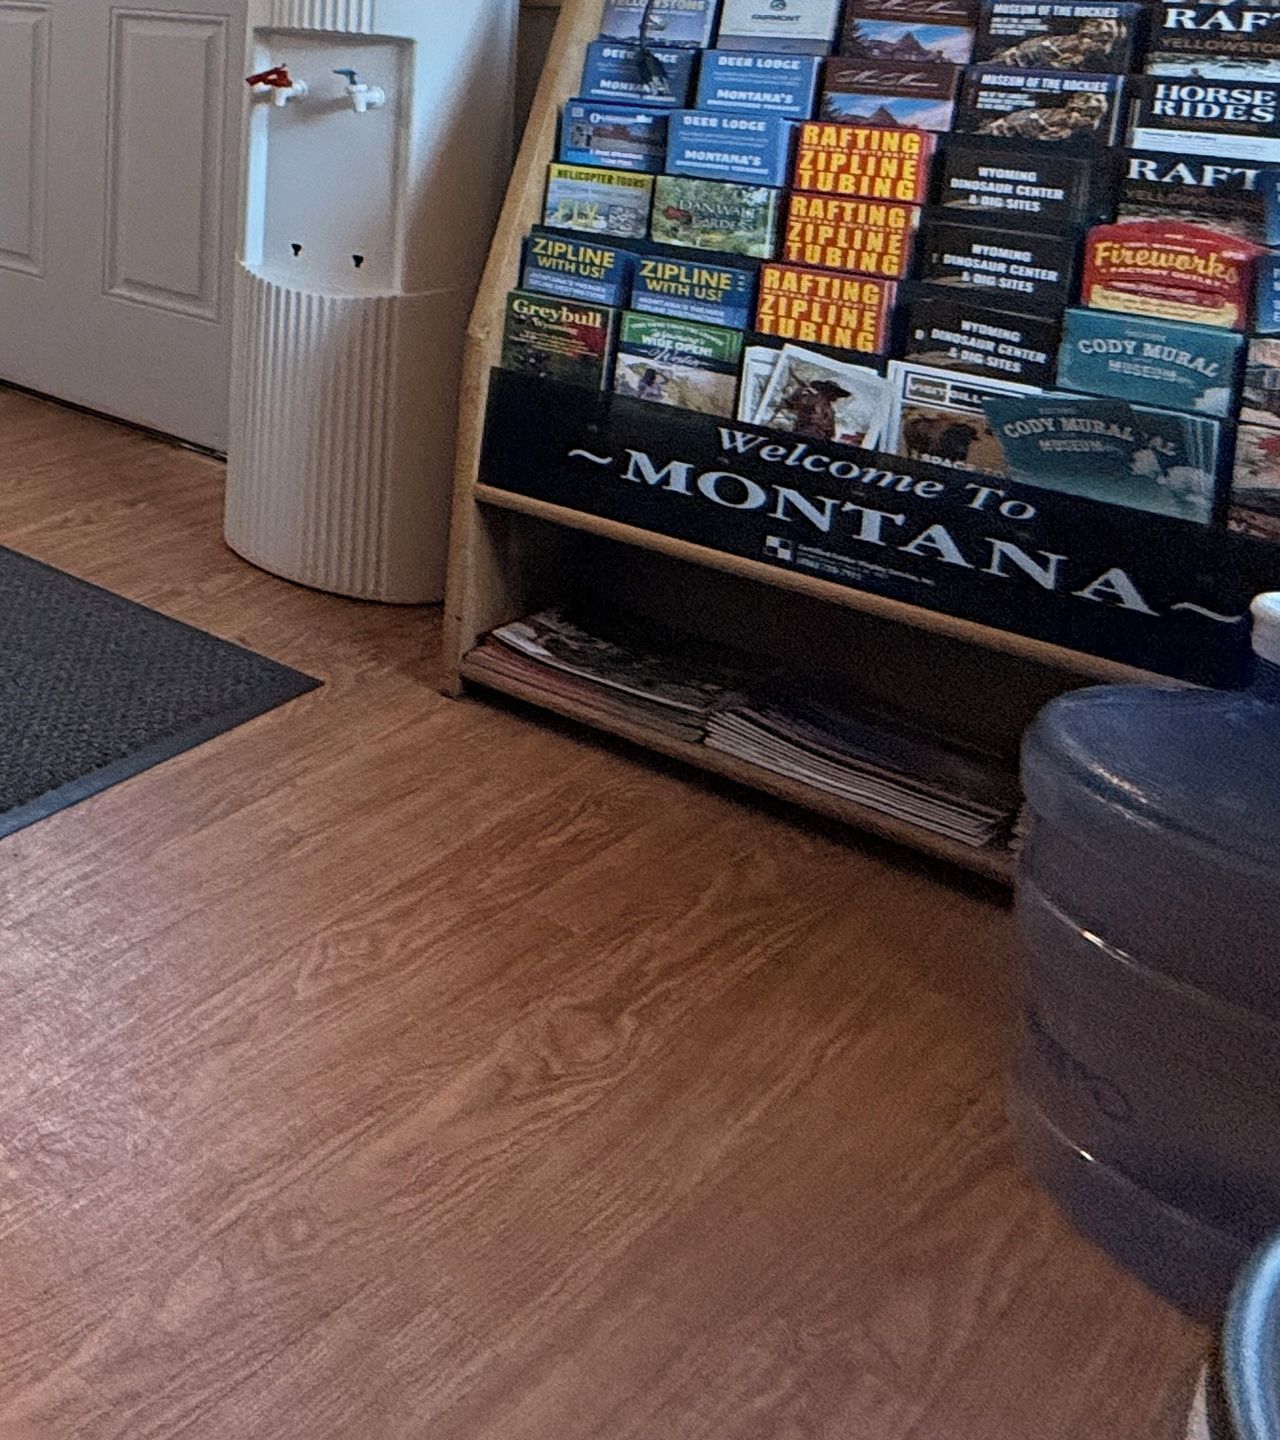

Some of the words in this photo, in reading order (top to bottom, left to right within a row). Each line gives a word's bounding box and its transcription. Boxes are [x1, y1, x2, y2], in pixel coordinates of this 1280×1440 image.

[717, 55, 754, 67] DEER
[756, 58, 801, 71] LODGE
[716, 88, 794, 104] MONTANA'S
[1155, 83, 1277, 106] HORSE
[683, 116, 719, 128] DEER
[721, 118, 767, 132] LODGE
[1151, 100, 1275, 122] RIDES
[803, 124, 921, 154] RAFTING
[684, 149, 762, 166] MONTANA'S
[799, 150, 917, 180] ZIPLINE
[798, 169, 915, 201] TUBING
[950, 177, 1013, 195] DINOSAUR
[1015, 184, 1064, 200] CENTER
[978, 166, 1037, 183] WYOMING
[1126, 158, 1261, 190] RAFT
[791, 196, 906, 228] RAFTING
[1006, 198, 1041, 213] SITES
[788, 221, 903, 255] ZIPLINE
[532, 238, 615, 269] ZIPLINE
[537, 254, 576, 274] WITH
[579, 264, 605, 279] US!
[787, 242, 900, 276] TUBING
[943, 253, 1007, 274] DINOSAUR
[1009, 264, 1058, 282] CENTER
[972, 244, 1032, 263] WYOMING
[1094, 241, 1239, 284] Fireworks
[640, 261, 732, 291] ZIPLINE
[645, 279, 690, 297] WITH
[693, 286, 722, 302] US!
[763, 268, 880, 304] RAFTING
[998, 277, 1035, 294] SITES
[512, 299, 602, 329] Greybull
[761, 294, 877, 332] ZIPLINE
[759, 313, 875, 353] TUBING
[931, 328, 996, 352] DINOSAUR
[998, 343, 1046, 363] CENTER
[961, 320, 1021, 342] WYOMING
[986, 354, 1022, 374] SITES
[1078, 338, 1137, 355] CODY
[1143, 342, 1220, 378] MURAL
[1003, 417, 1056, 439] CODY
[1059, 417, 1134, 443] MURAL
[716, 426, 944, 501] Welcome
[965, 481, 1038, 522] To
